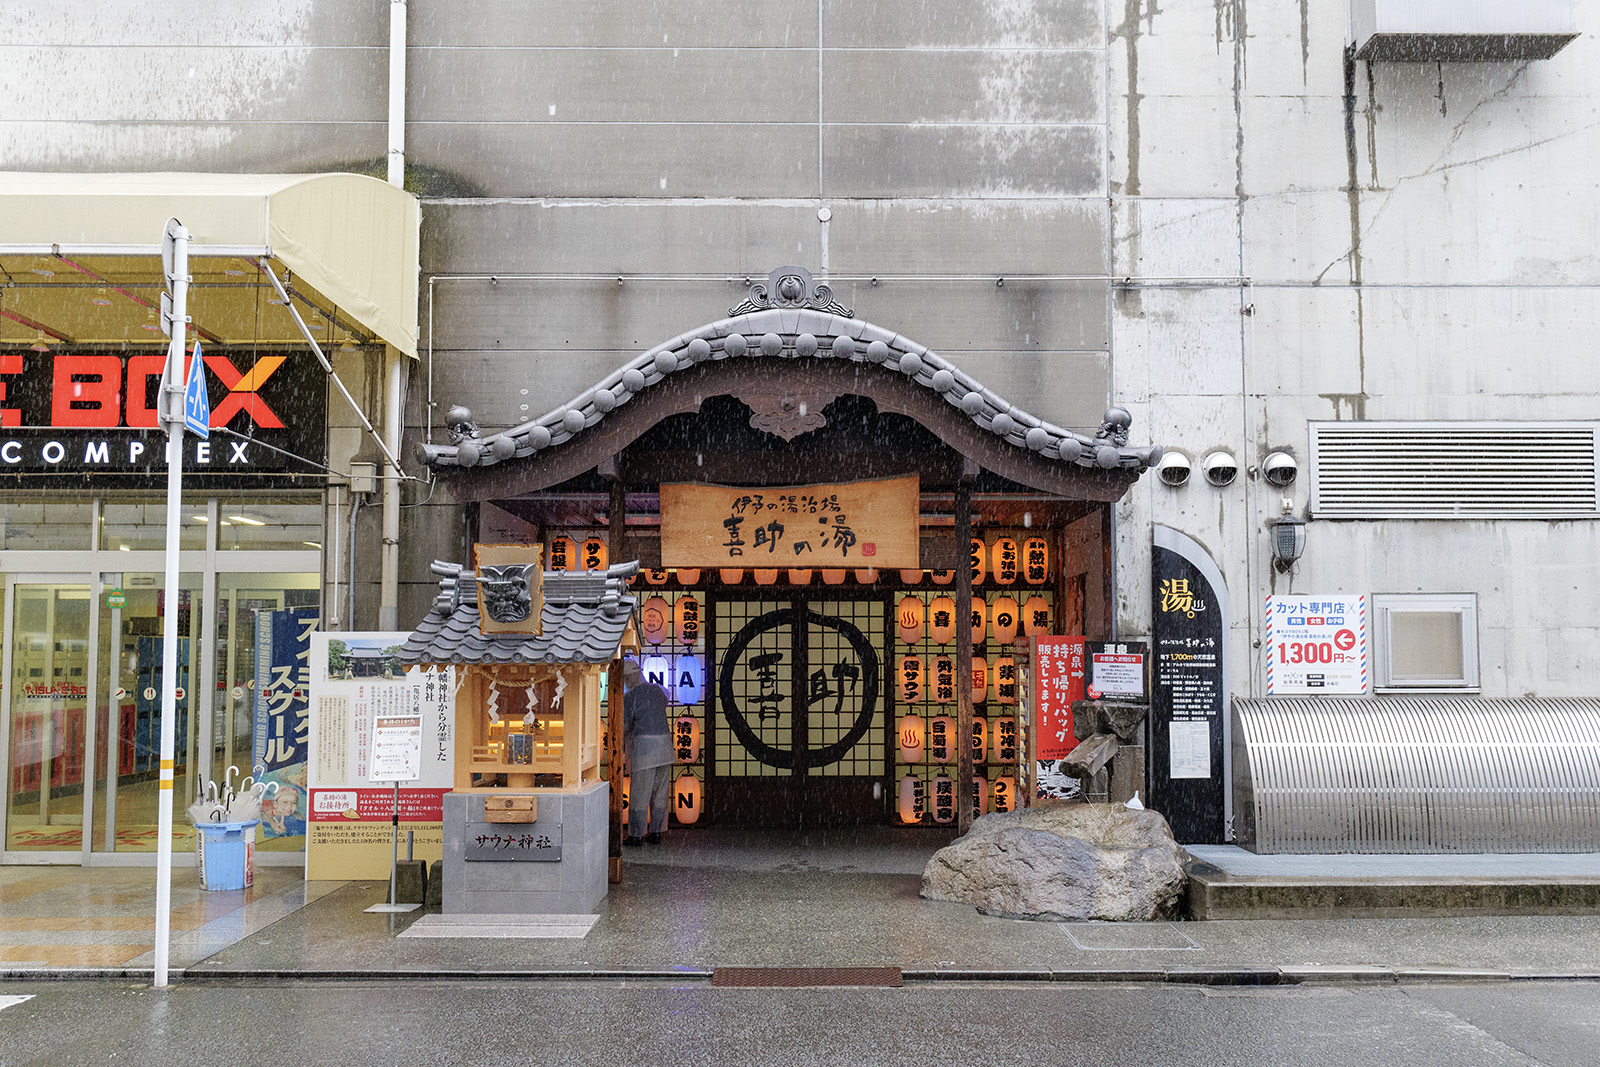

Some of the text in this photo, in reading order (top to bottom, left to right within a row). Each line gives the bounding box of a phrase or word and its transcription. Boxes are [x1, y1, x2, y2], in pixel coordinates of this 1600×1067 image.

[1, 441, 250, 464] COMPEX
[731, 495, 841, 514] 伊予の湯治場
[723, 514, 856, 557] 喜助の湯
[552, 541, 566, 570] 岩盤
[586, 543, 600, 570] サウ
[1160, 578, 1194, 619] 湯。
[1276, 602, 1344, 614] カット専門店
[1070, 643, 1084, 668] 源泉
[1053, 643, 1070, 742] 持ち帰りバッグ
[264, 665, 296, 764] スクール
[437, 666, 448, 762] 幡神社から分霊した
[318, 801, 350, 809] お接待所
[936, 781, 952, 819] 炭酸泉
[475, 834, 552, 850] サウナ神社
